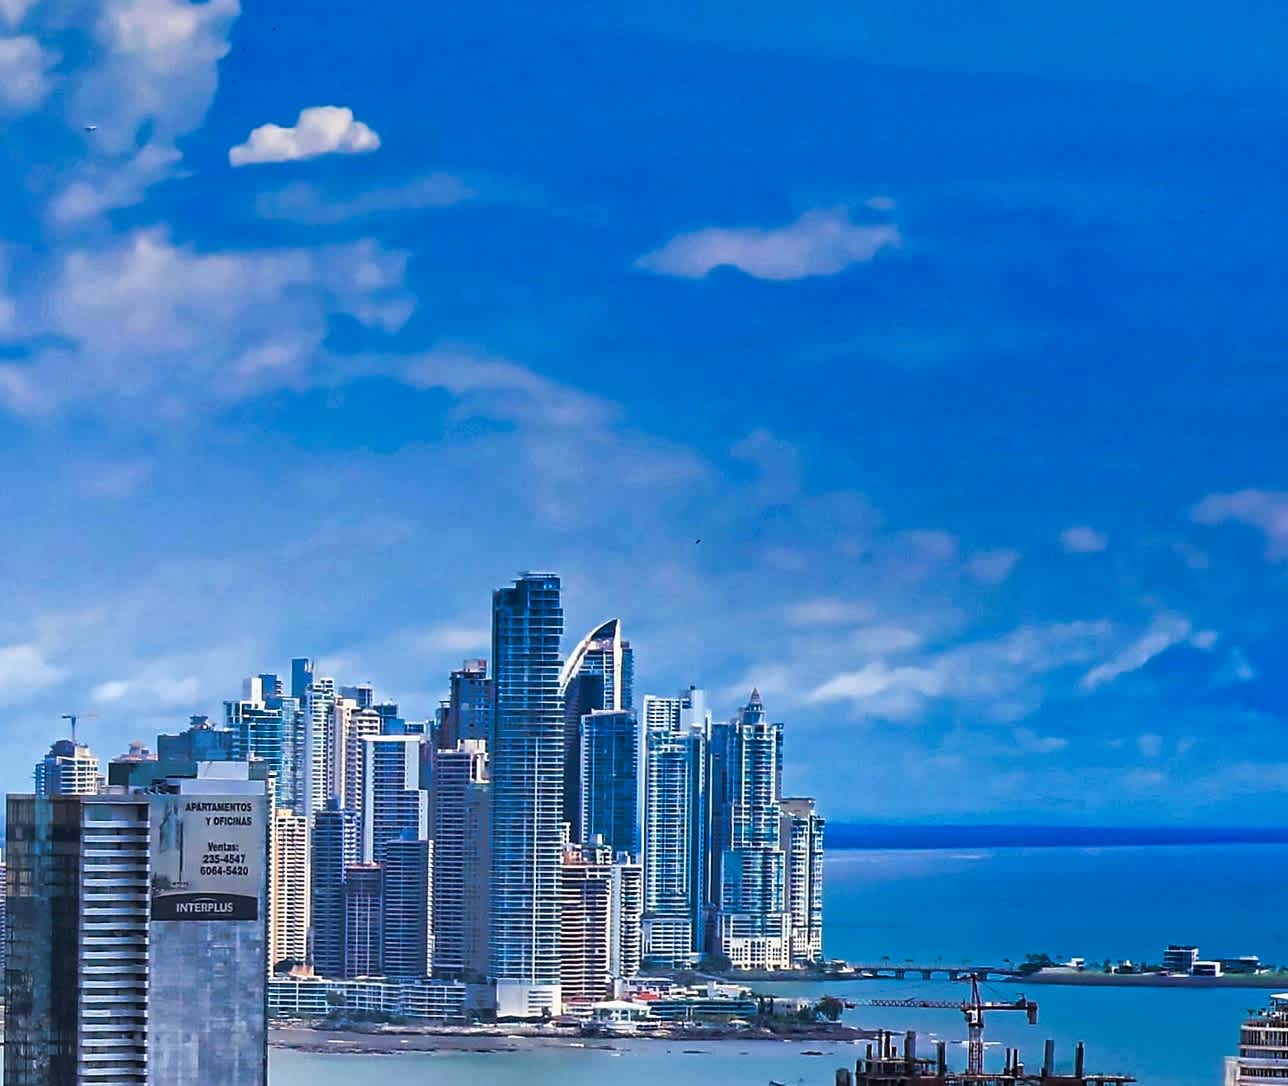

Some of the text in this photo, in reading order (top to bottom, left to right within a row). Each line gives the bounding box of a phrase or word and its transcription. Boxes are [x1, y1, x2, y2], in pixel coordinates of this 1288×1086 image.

[185, 802, 252, 812] APARTAMENTOS
[205, 816, 252, 826] Y OFICINAS
[207, 841, 240, 852] Ventas:
[202, 854, 246, 864] 235-4547
[199, 866, 249, 876] 6064-5420
[176, 902, 234, 913] INTERPLUS
